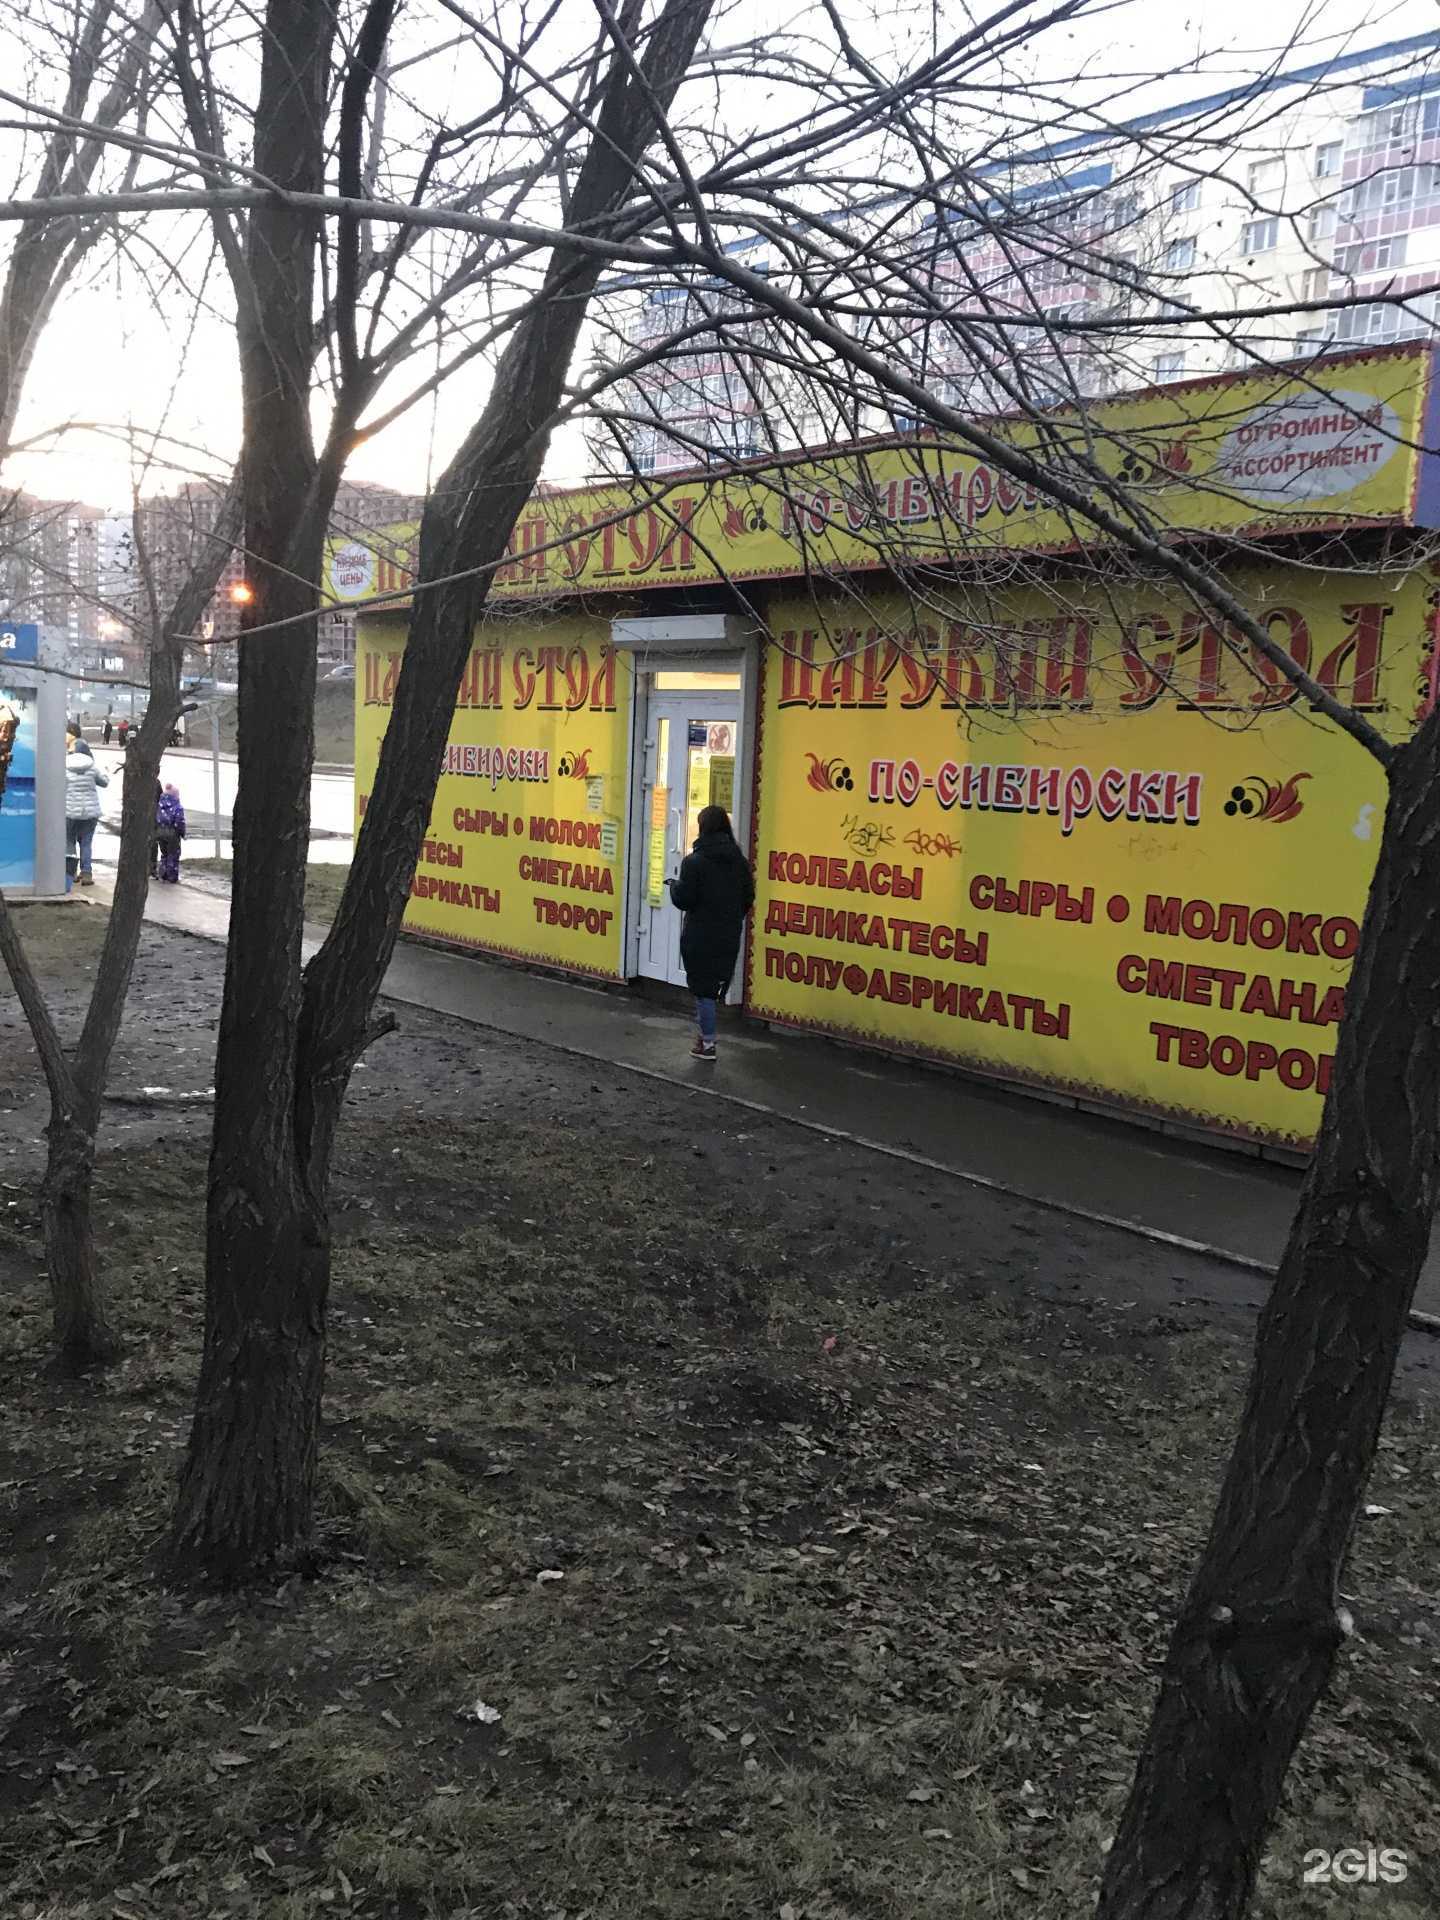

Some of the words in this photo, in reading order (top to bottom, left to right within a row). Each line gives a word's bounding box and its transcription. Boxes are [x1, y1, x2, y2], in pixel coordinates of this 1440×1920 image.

[1236, 405, 1384, 446] ОГРОМНЫЙ
[1230, 442, 1385, 481] АССОРТИМЕНТ
[562, 497, 698, 579] СТОЛ
[340, 573, 364, 586] ЦЕНЫ
[513, 645, 618, 712] СТОЛ
[778, 606, 1094, 711] ЦАРСКИЙ
[1120, 602, 1394, 713] СТОЛ
[453, 807, 509, 838] СЫРЫ
[529, 816, 601, 850] МОЛОК
[518, 855, 615, 896] СМЕТАНА
[767, 850, 924, 901] КОЛБАСЫ
[532, 896, 614, 937] ТВОРОГ
[763, 899, 990, 967] ДЕЛИКАТЕСЫ
[968, 874, 1096, 925] СЫРЫ
[1143, 893, 1361, 961] МОЛОКО
[764, 946, 1071, 1041] ПОЛУФАБРИКАТЫ
[1115, 953, 1350, 1027] СМЕТАНА
